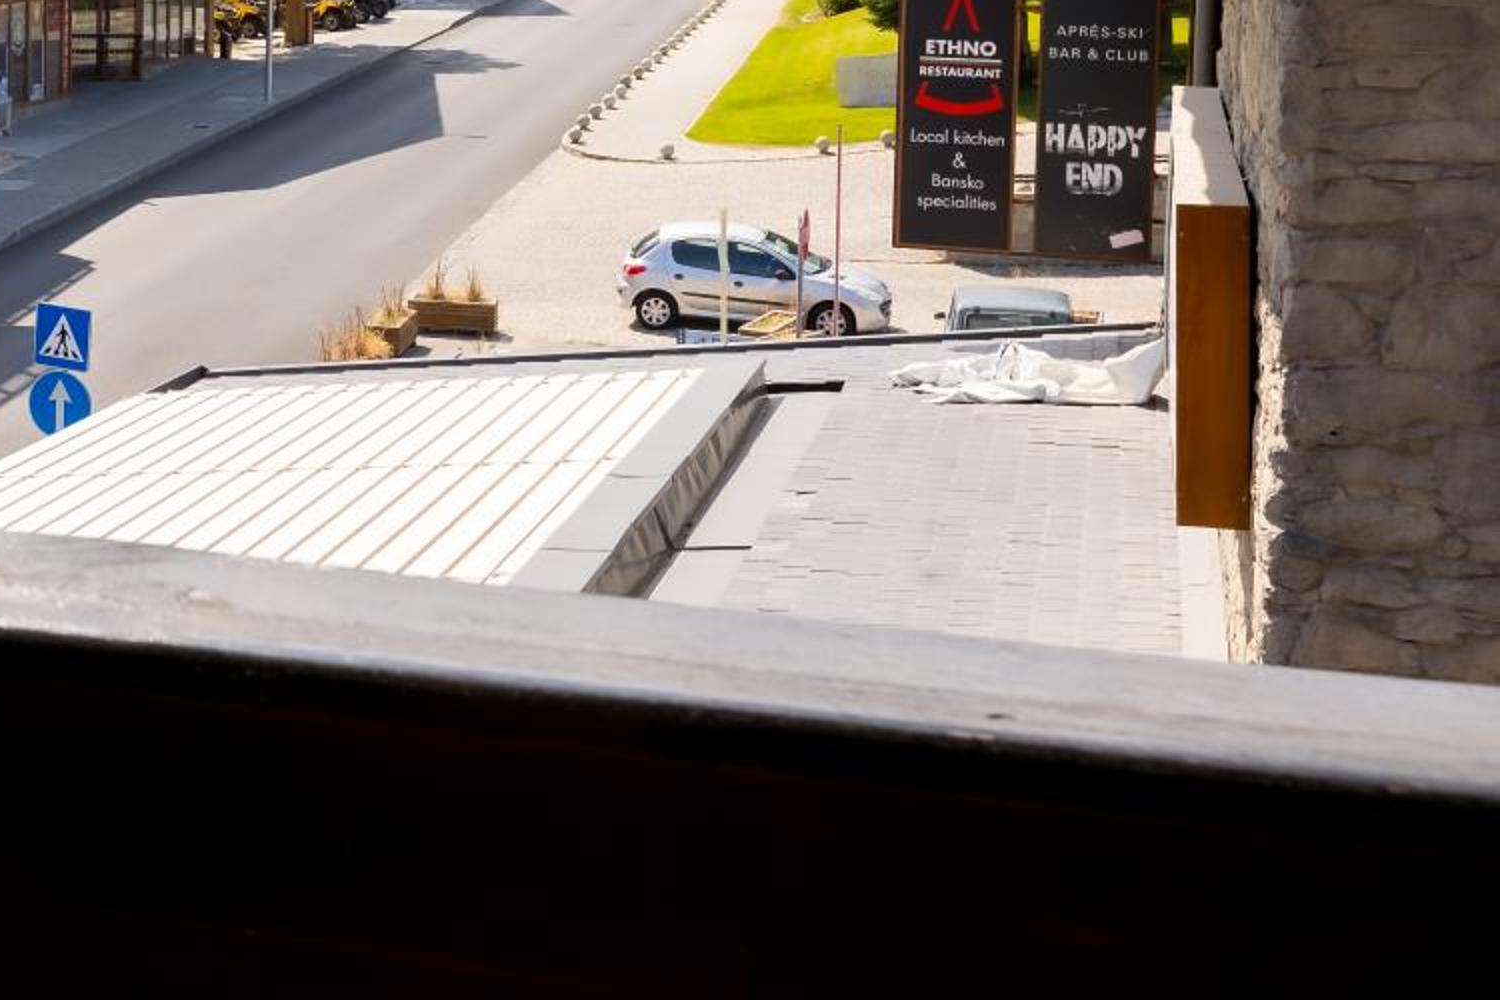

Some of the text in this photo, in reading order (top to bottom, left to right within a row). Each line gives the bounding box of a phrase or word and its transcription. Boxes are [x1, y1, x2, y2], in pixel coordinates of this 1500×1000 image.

[925, 39, 997, 56] ETHNO
[1049, 48, 1149, 62] BAR & CLUB
[919, 65, 1002, 79] RESTAURANT
[910, 127, 1005, 147] Local kitchen
[1045, 122, 1147, 158] HAPPY
[952, 152, 966, 169] &
[931, 173, 985, 190] Bansko
[1065, 162, 1124, 196] END
[917, 194, 997, 212] specialities
